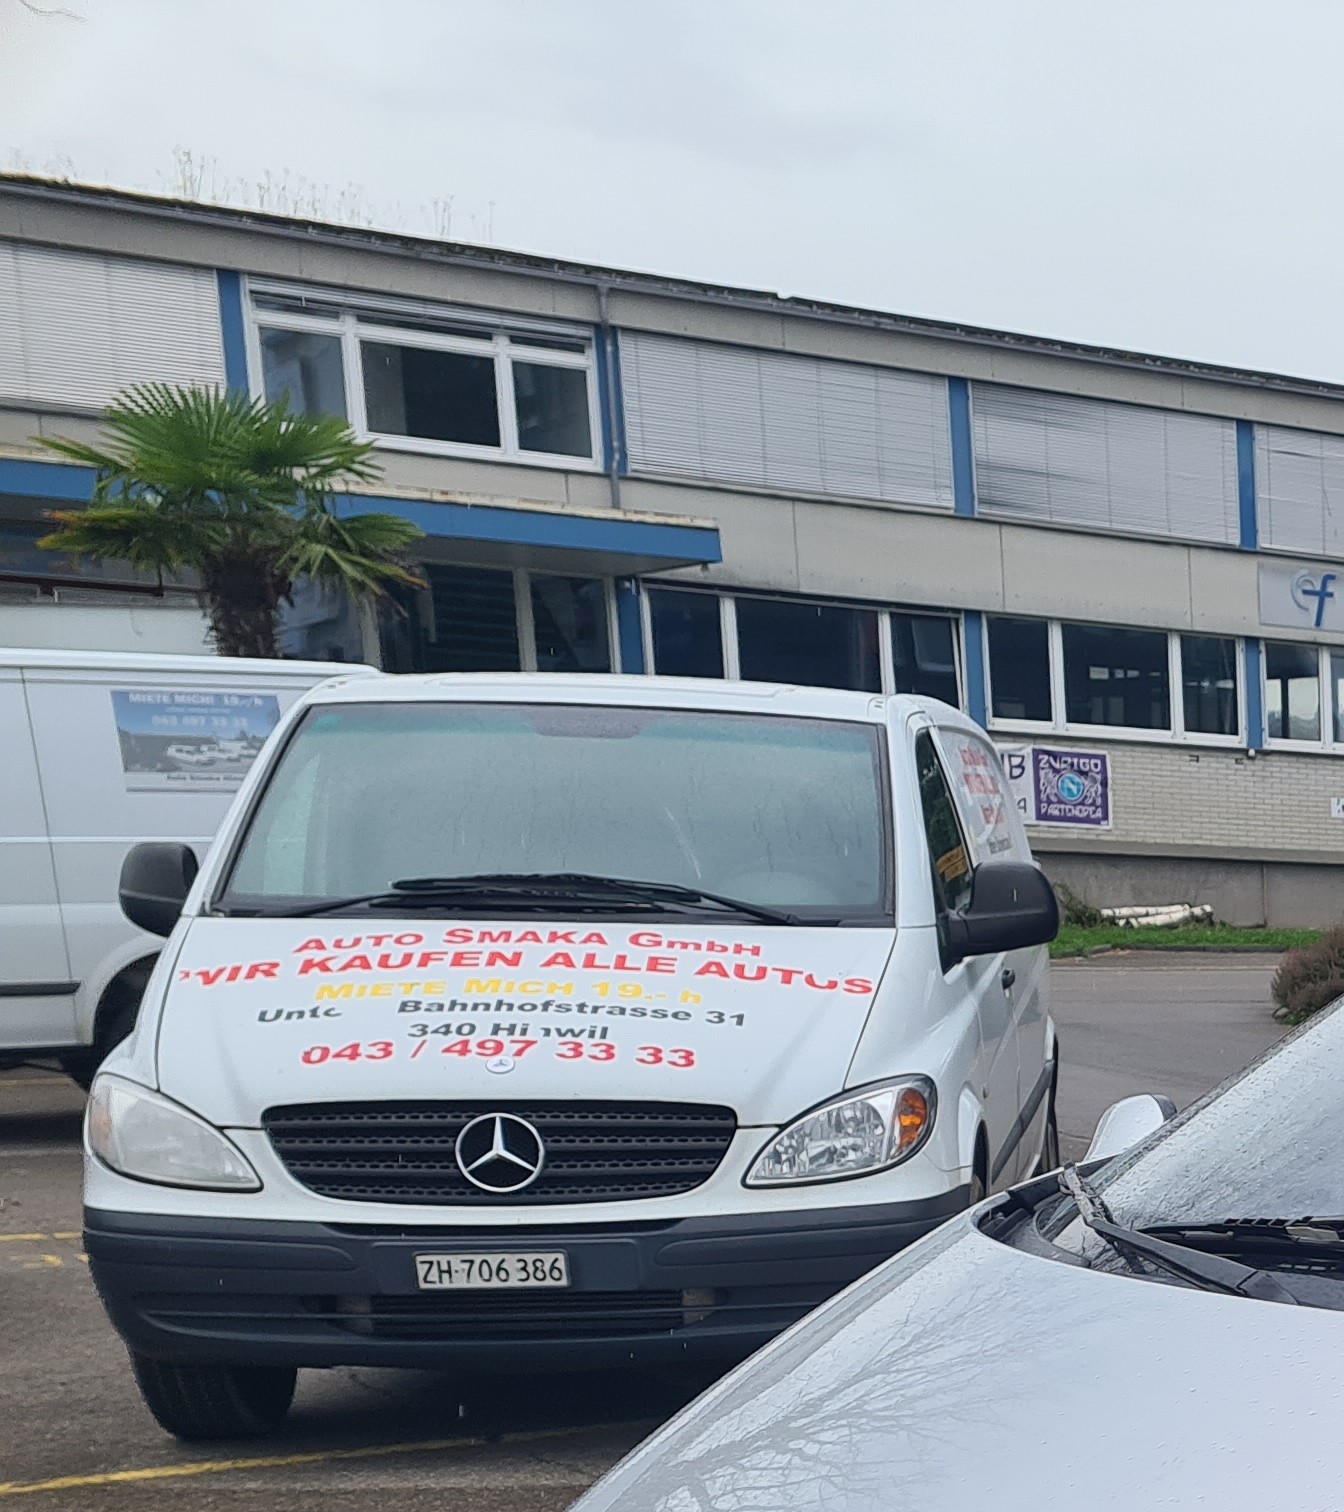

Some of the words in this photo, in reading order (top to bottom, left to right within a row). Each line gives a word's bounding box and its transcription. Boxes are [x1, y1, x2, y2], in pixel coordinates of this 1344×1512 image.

[293, 933, 424, 953] AUTO
[442, 928, 609, 946] SMAKA
[628, 932, 762, 957] GmbH
[298, 951, 523, 975] KAUFEN
[540, 952, 678, 974] ALLE
[315, 981, 446, 1000] MIETE
[463, 978, 575, 996] MICH
[397, 998, 693, 1021] Bahnhofstrasse
[704, 1010, 746, 1027] 31
[301, 1041, 394, 1065] 043
[411, 1039, 427, 1058] /
[441, 1039, 539, 1058] 497
[555, 1041, 616, 1061] 33
[635, 1046, 696, 1068] 33
